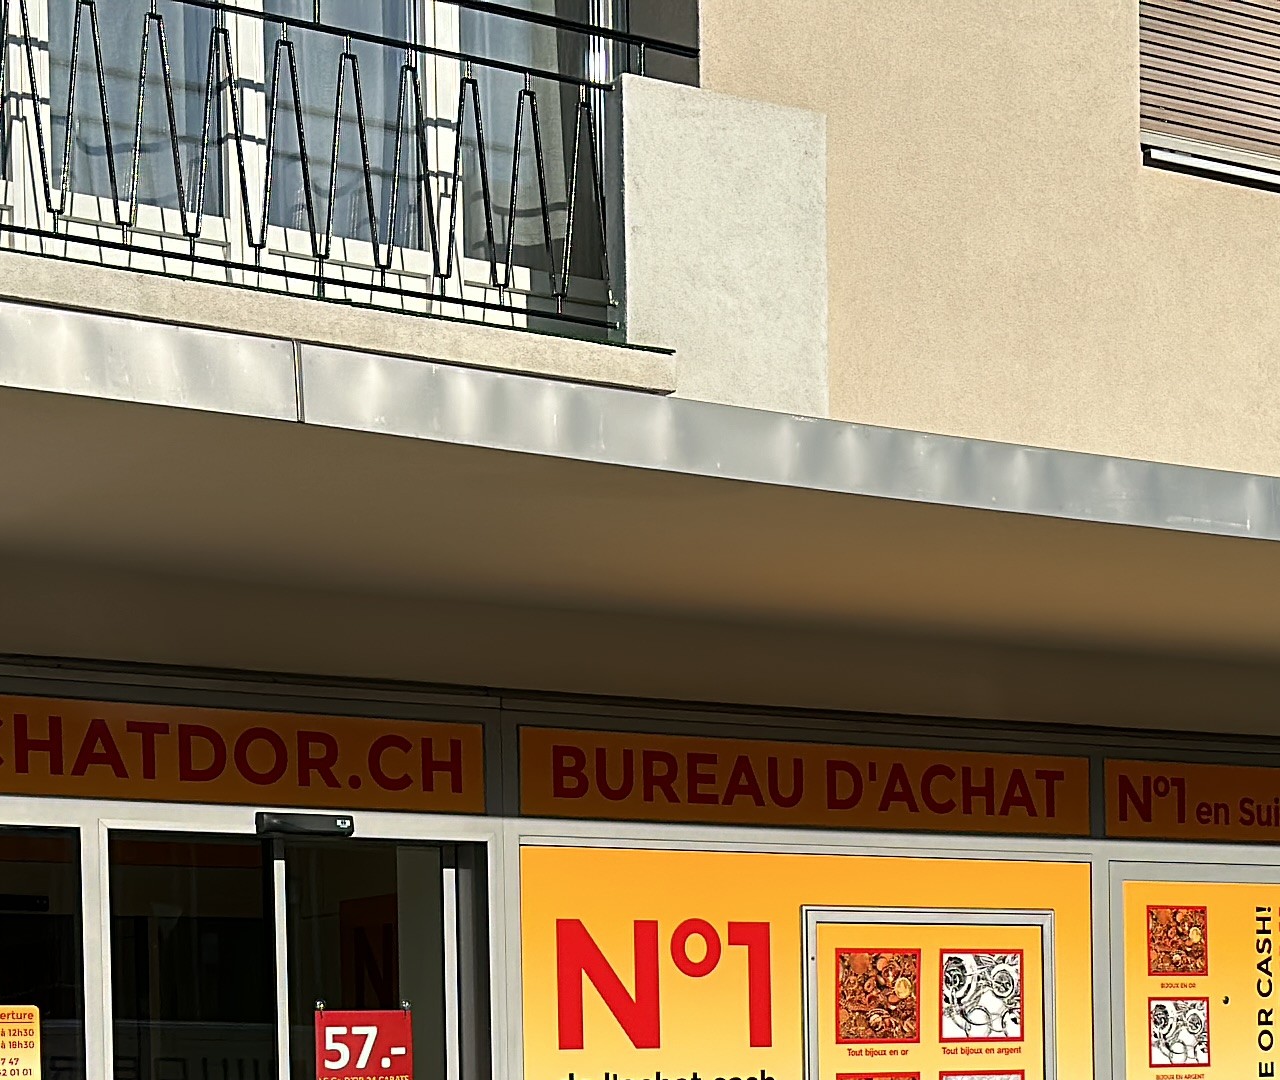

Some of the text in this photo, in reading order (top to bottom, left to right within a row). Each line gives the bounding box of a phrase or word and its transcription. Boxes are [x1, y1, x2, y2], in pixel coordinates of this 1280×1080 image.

[553, 745, 1064, 817] BUREAU D'ACHAT
[1196, 802, 1229, 825] en
[1256, 906, 1272, 997] CASH!
[1, 1028, 5, 1037] à
[324, 1026, 406, 1070] 57.-
[1258, 1008, 1273, 1051] OR
